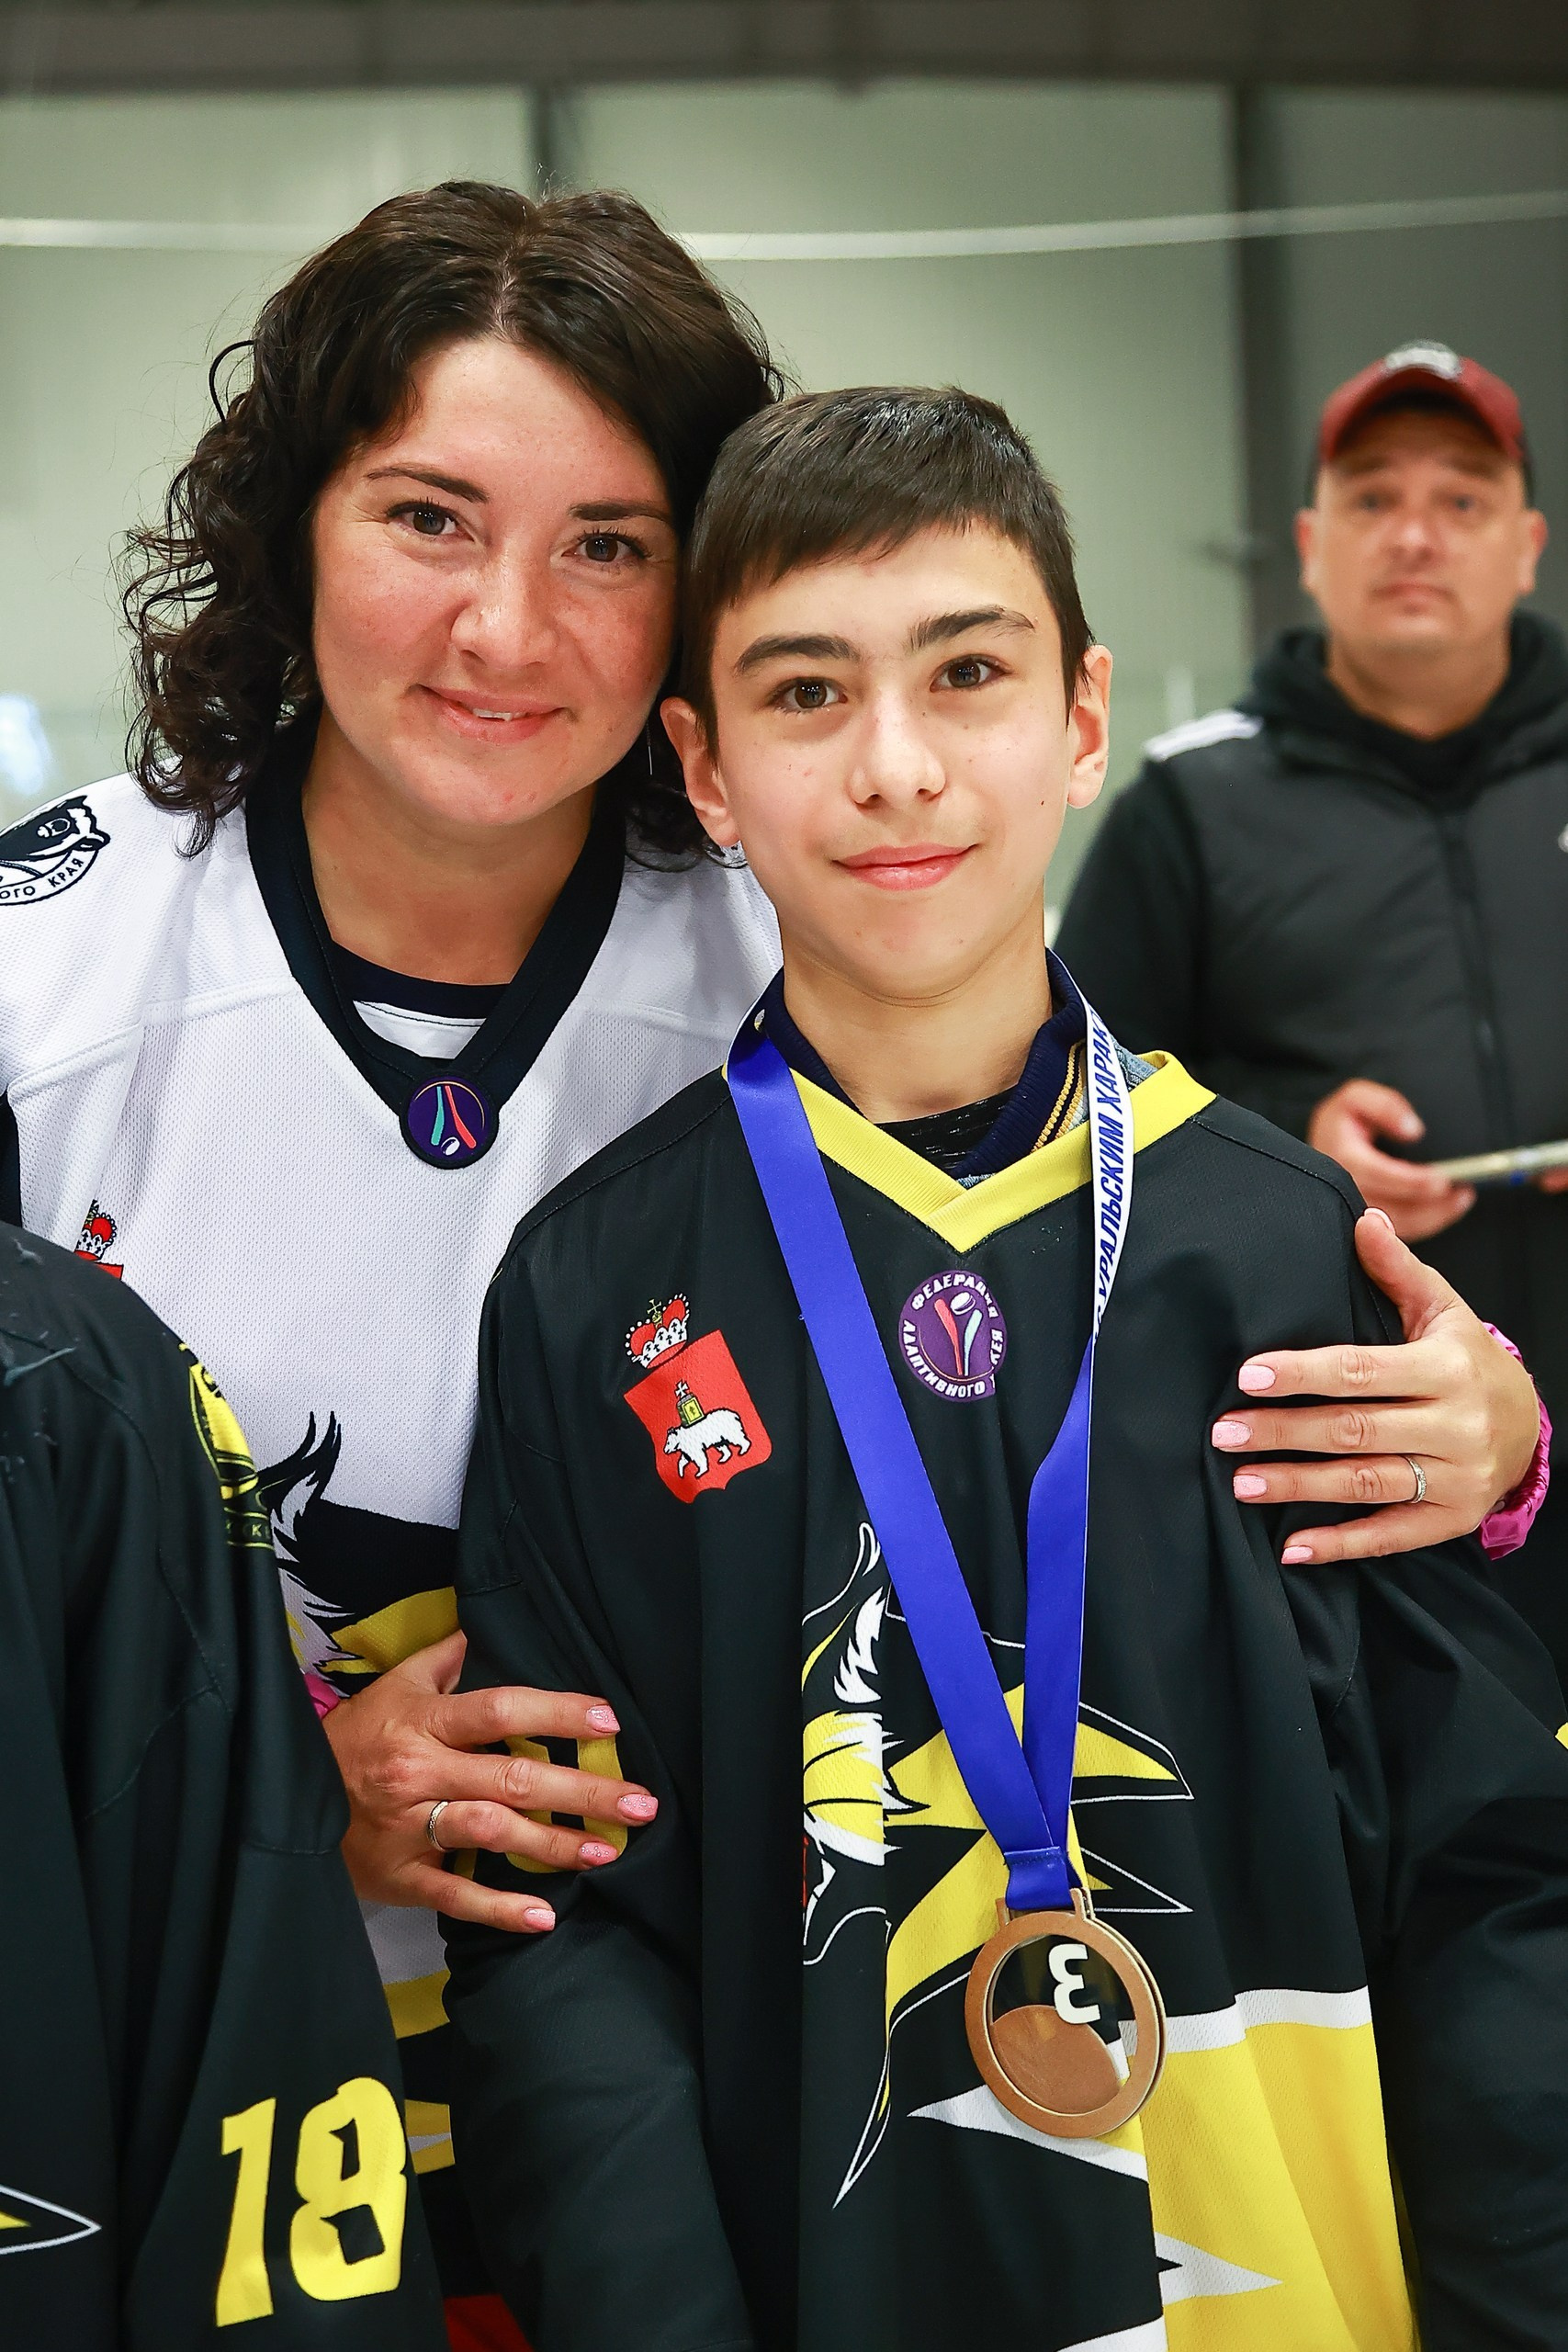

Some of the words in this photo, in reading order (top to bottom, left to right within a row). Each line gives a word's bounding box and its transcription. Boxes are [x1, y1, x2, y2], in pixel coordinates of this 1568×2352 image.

[47, 857, 85, 888] КРАЯ
[910, 1273, 999, 1317] ФЕДЕРАЦИЯ
[215, 2075, 407, 2328] 18
